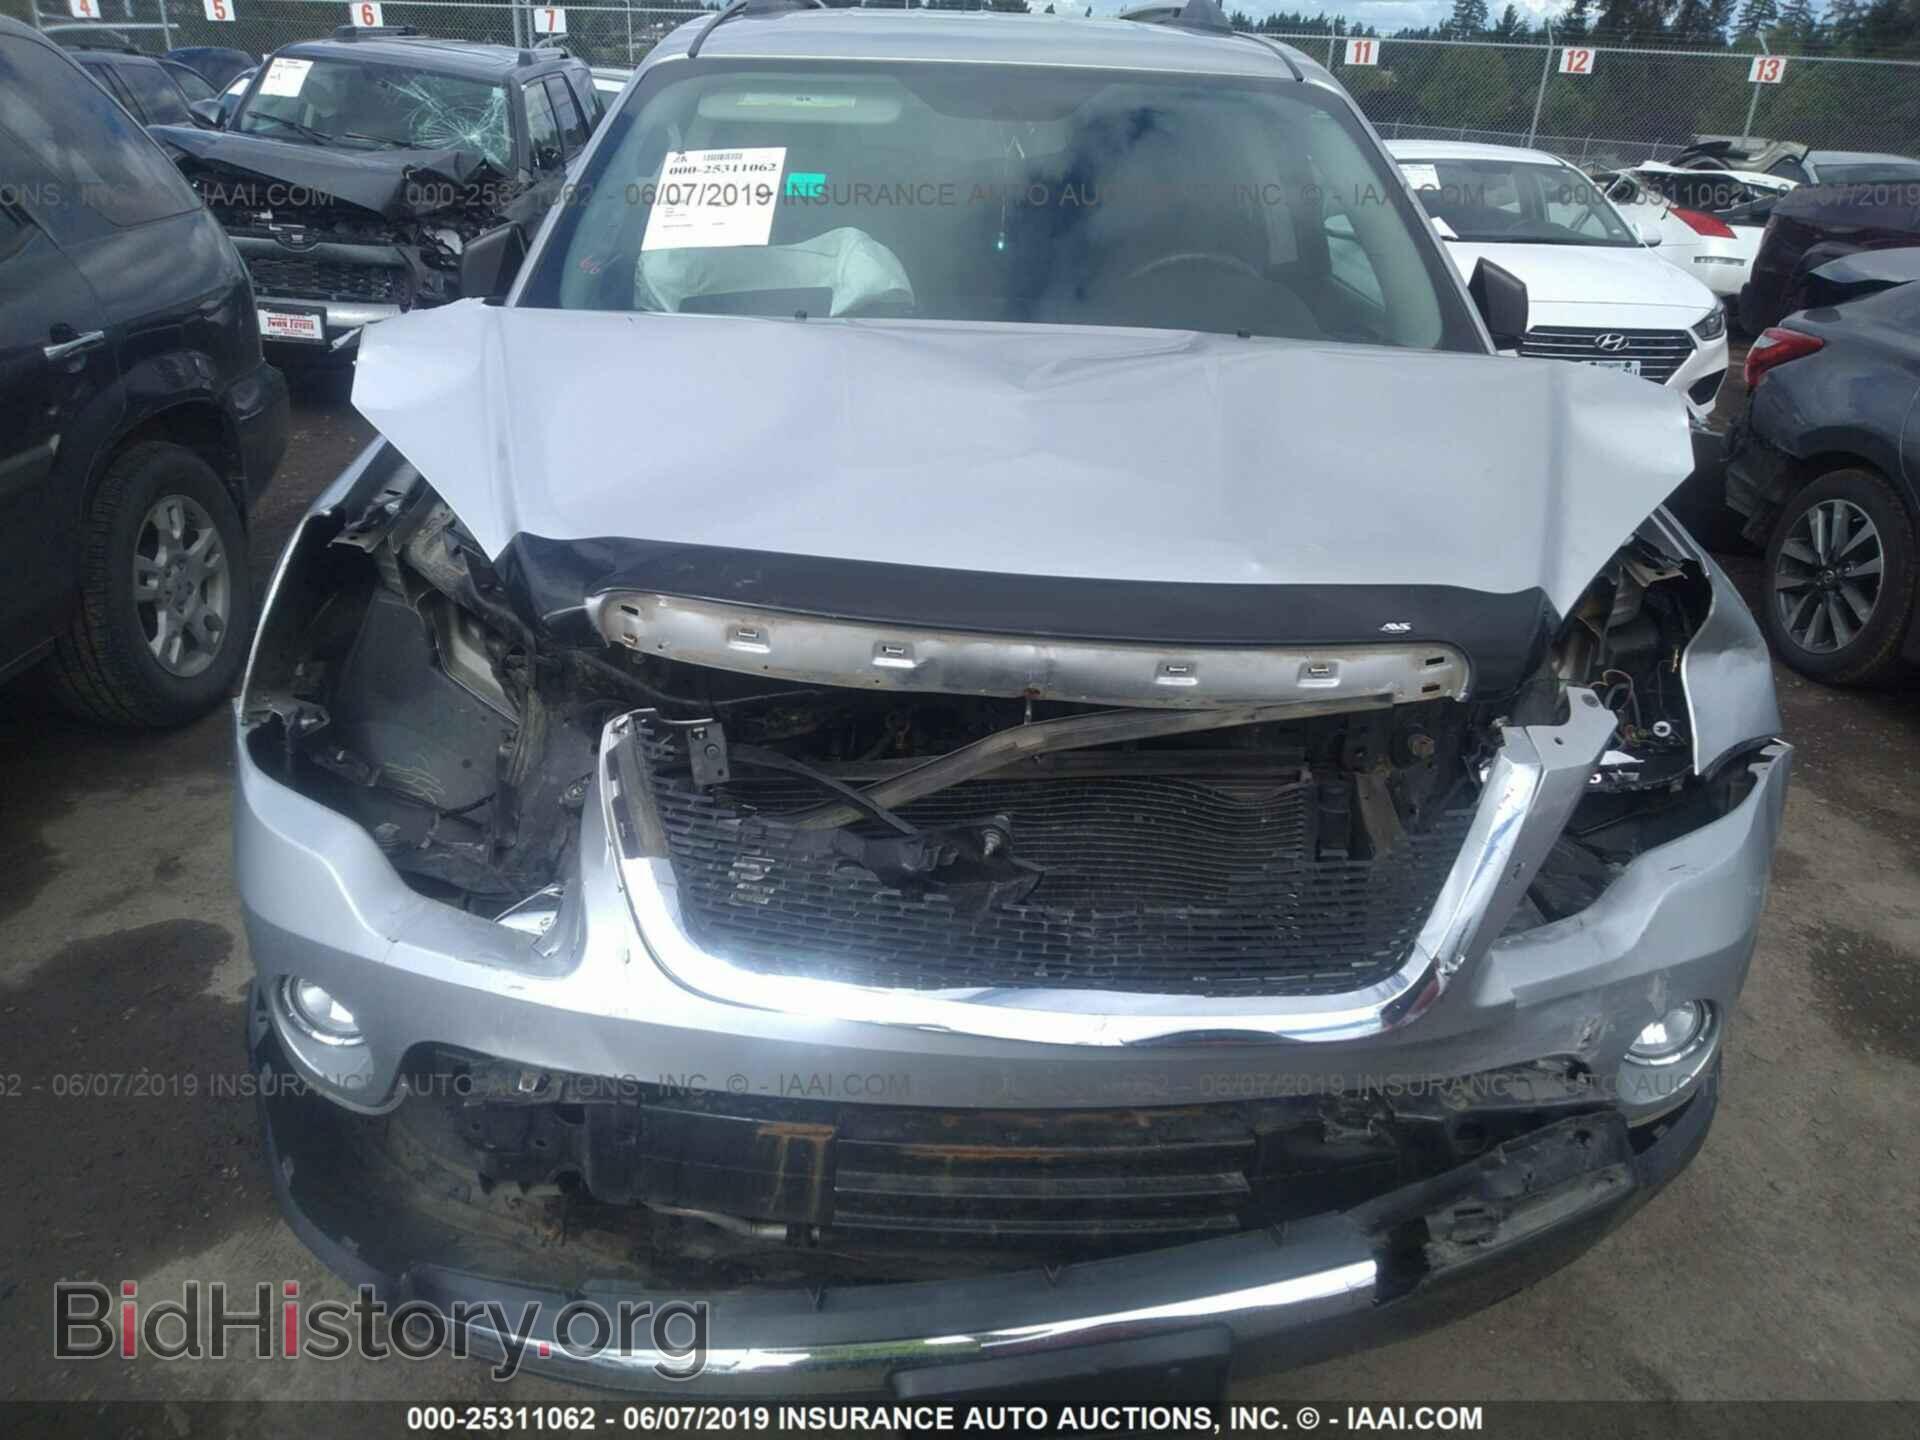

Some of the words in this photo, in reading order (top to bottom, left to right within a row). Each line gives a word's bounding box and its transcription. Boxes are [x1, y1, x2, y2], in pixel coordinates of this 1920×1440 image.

[79, 0, 92, 17] 4
[212, 0, 227, 20] 5
[361, 3, 375, 26] 6
[544, 9, 556, 32] 7
[1353, 41, 1372, 63] 11
[1566, 49, 1590, 72] 12
[1756, 58, 1780, 82] 13
[669, 163, 777, 176] 000-25311062
